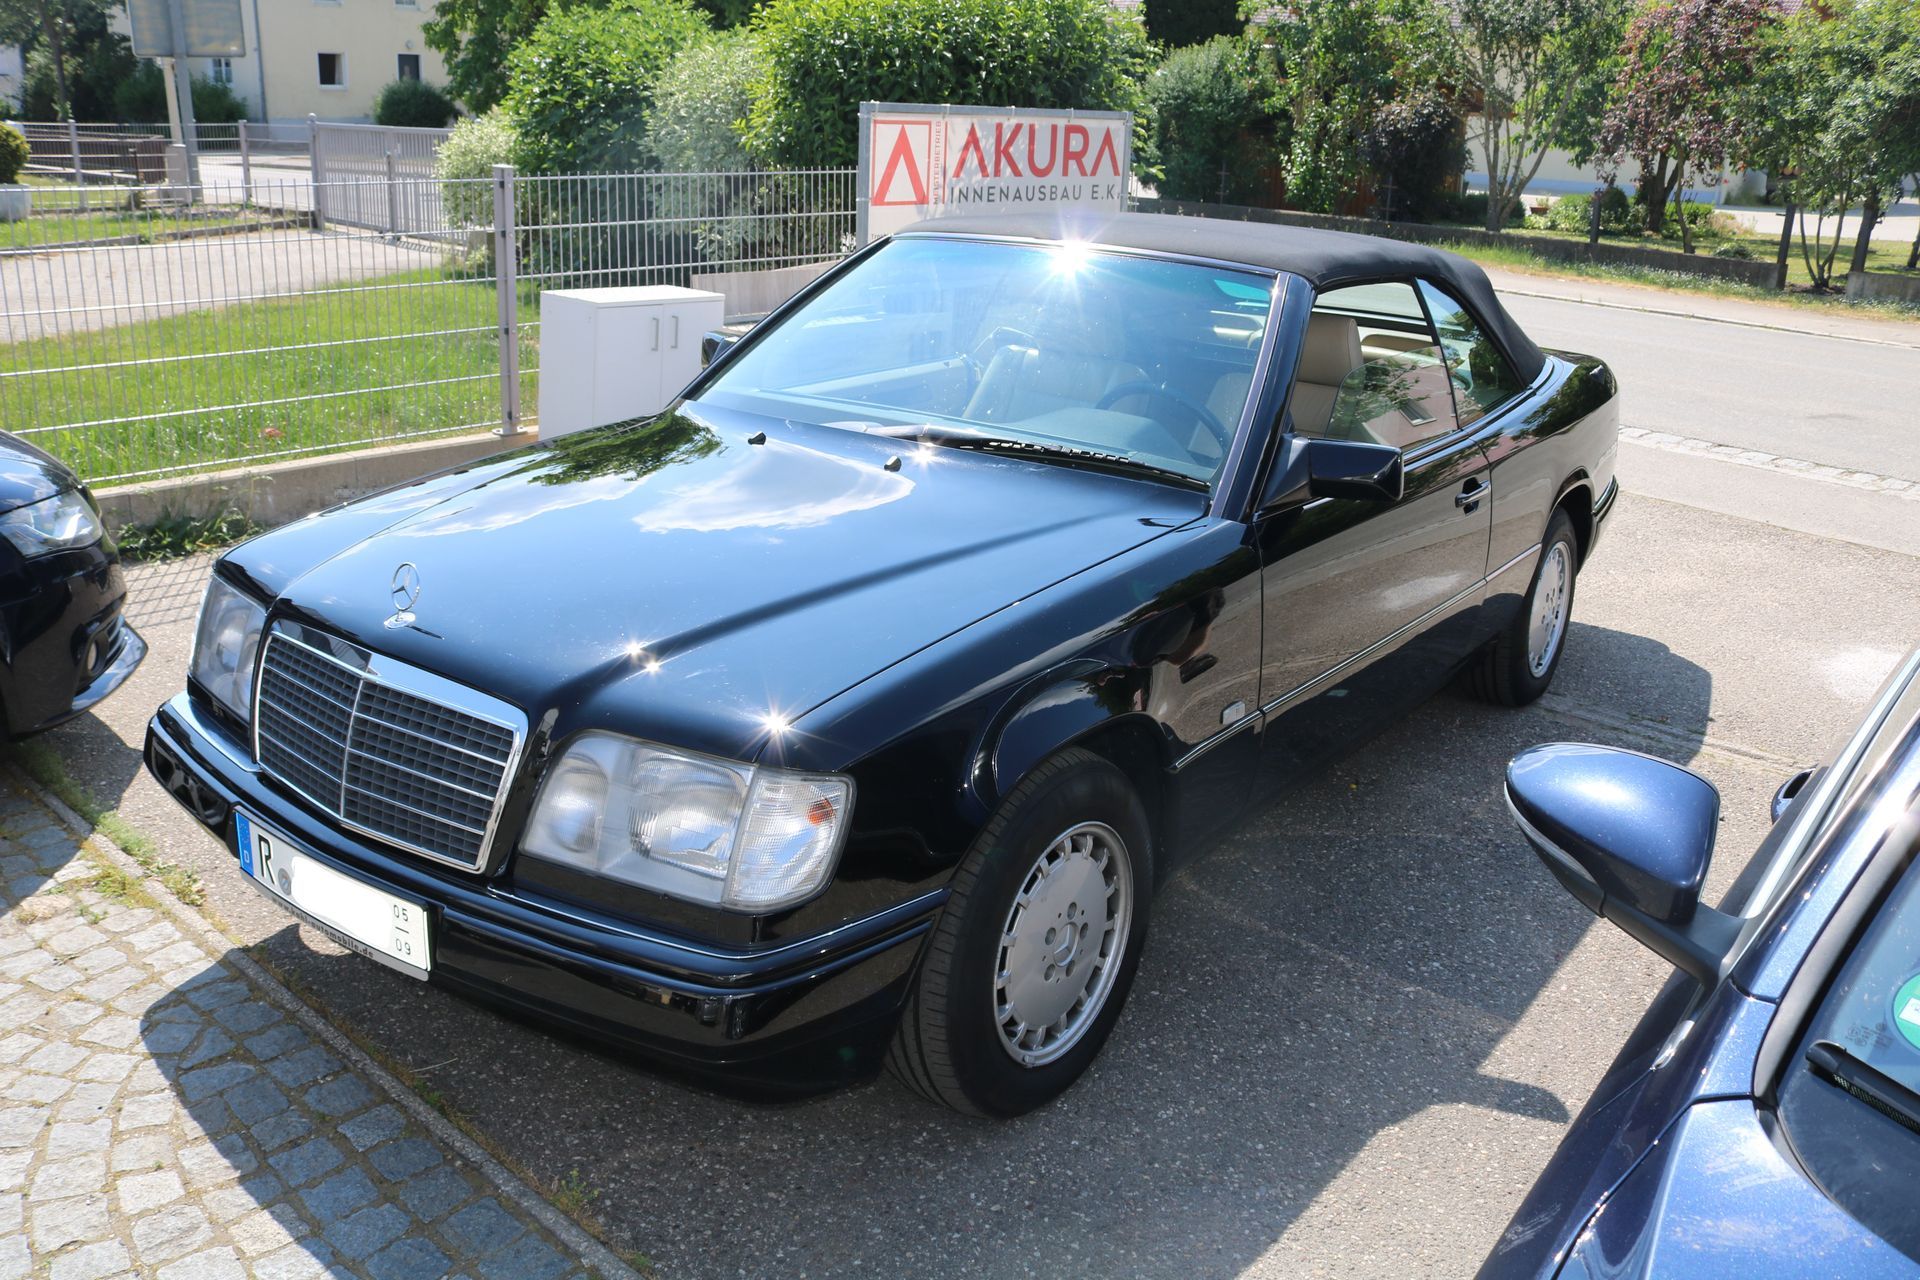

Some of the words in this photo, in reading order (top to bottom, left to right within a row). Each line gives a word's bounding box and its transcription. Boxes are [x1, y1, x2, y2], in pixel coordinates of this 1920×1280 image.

[952, 122, 1121, 178] AKURA
[951, 184, 1083, 204] INNENAUSBAU
[243, 850, 250, 864] D
[258, 833, 276, 885] R
[393, 904, 409, 922] 05
[395, 938, 411, 956] 09
